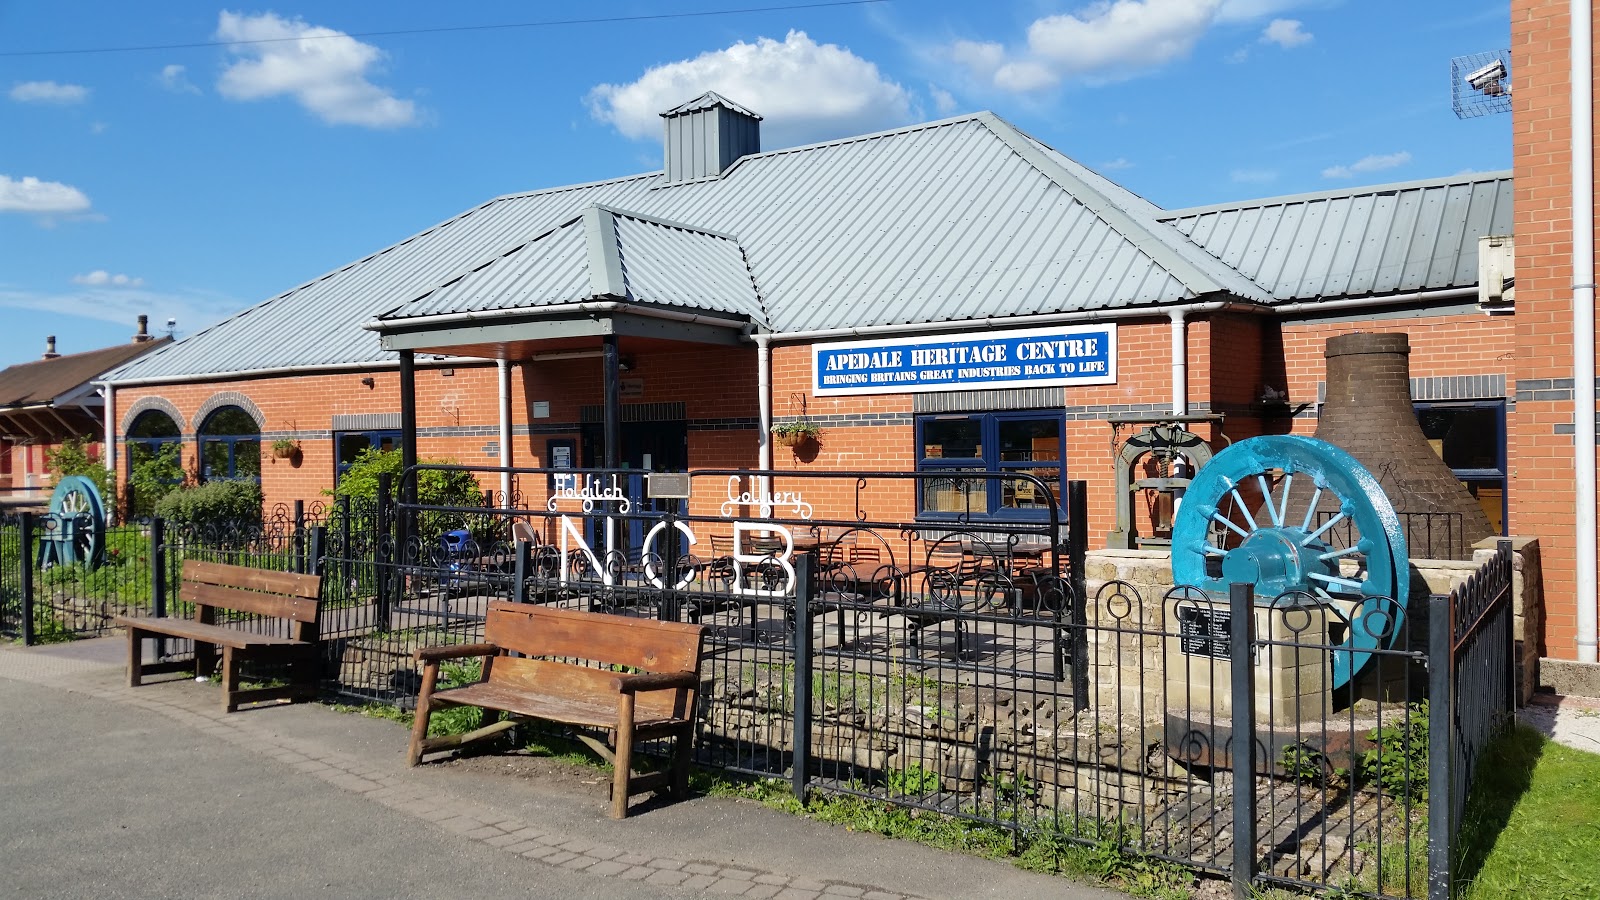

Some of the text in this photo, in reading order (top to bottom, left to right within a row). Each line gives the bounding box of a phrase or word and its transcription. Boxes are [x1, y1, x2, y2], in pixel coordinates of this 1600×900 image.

[826, 338, 1098, 371] APEDALE HERITAGE CENTRE
[823, 361, 1105, 384] BRINGING BRITAINS GREAT INDUSTRIES BACK TO LIFE
[554, 474, 623, 498] Holditch
[728, 475, 802, 513] Colliery
